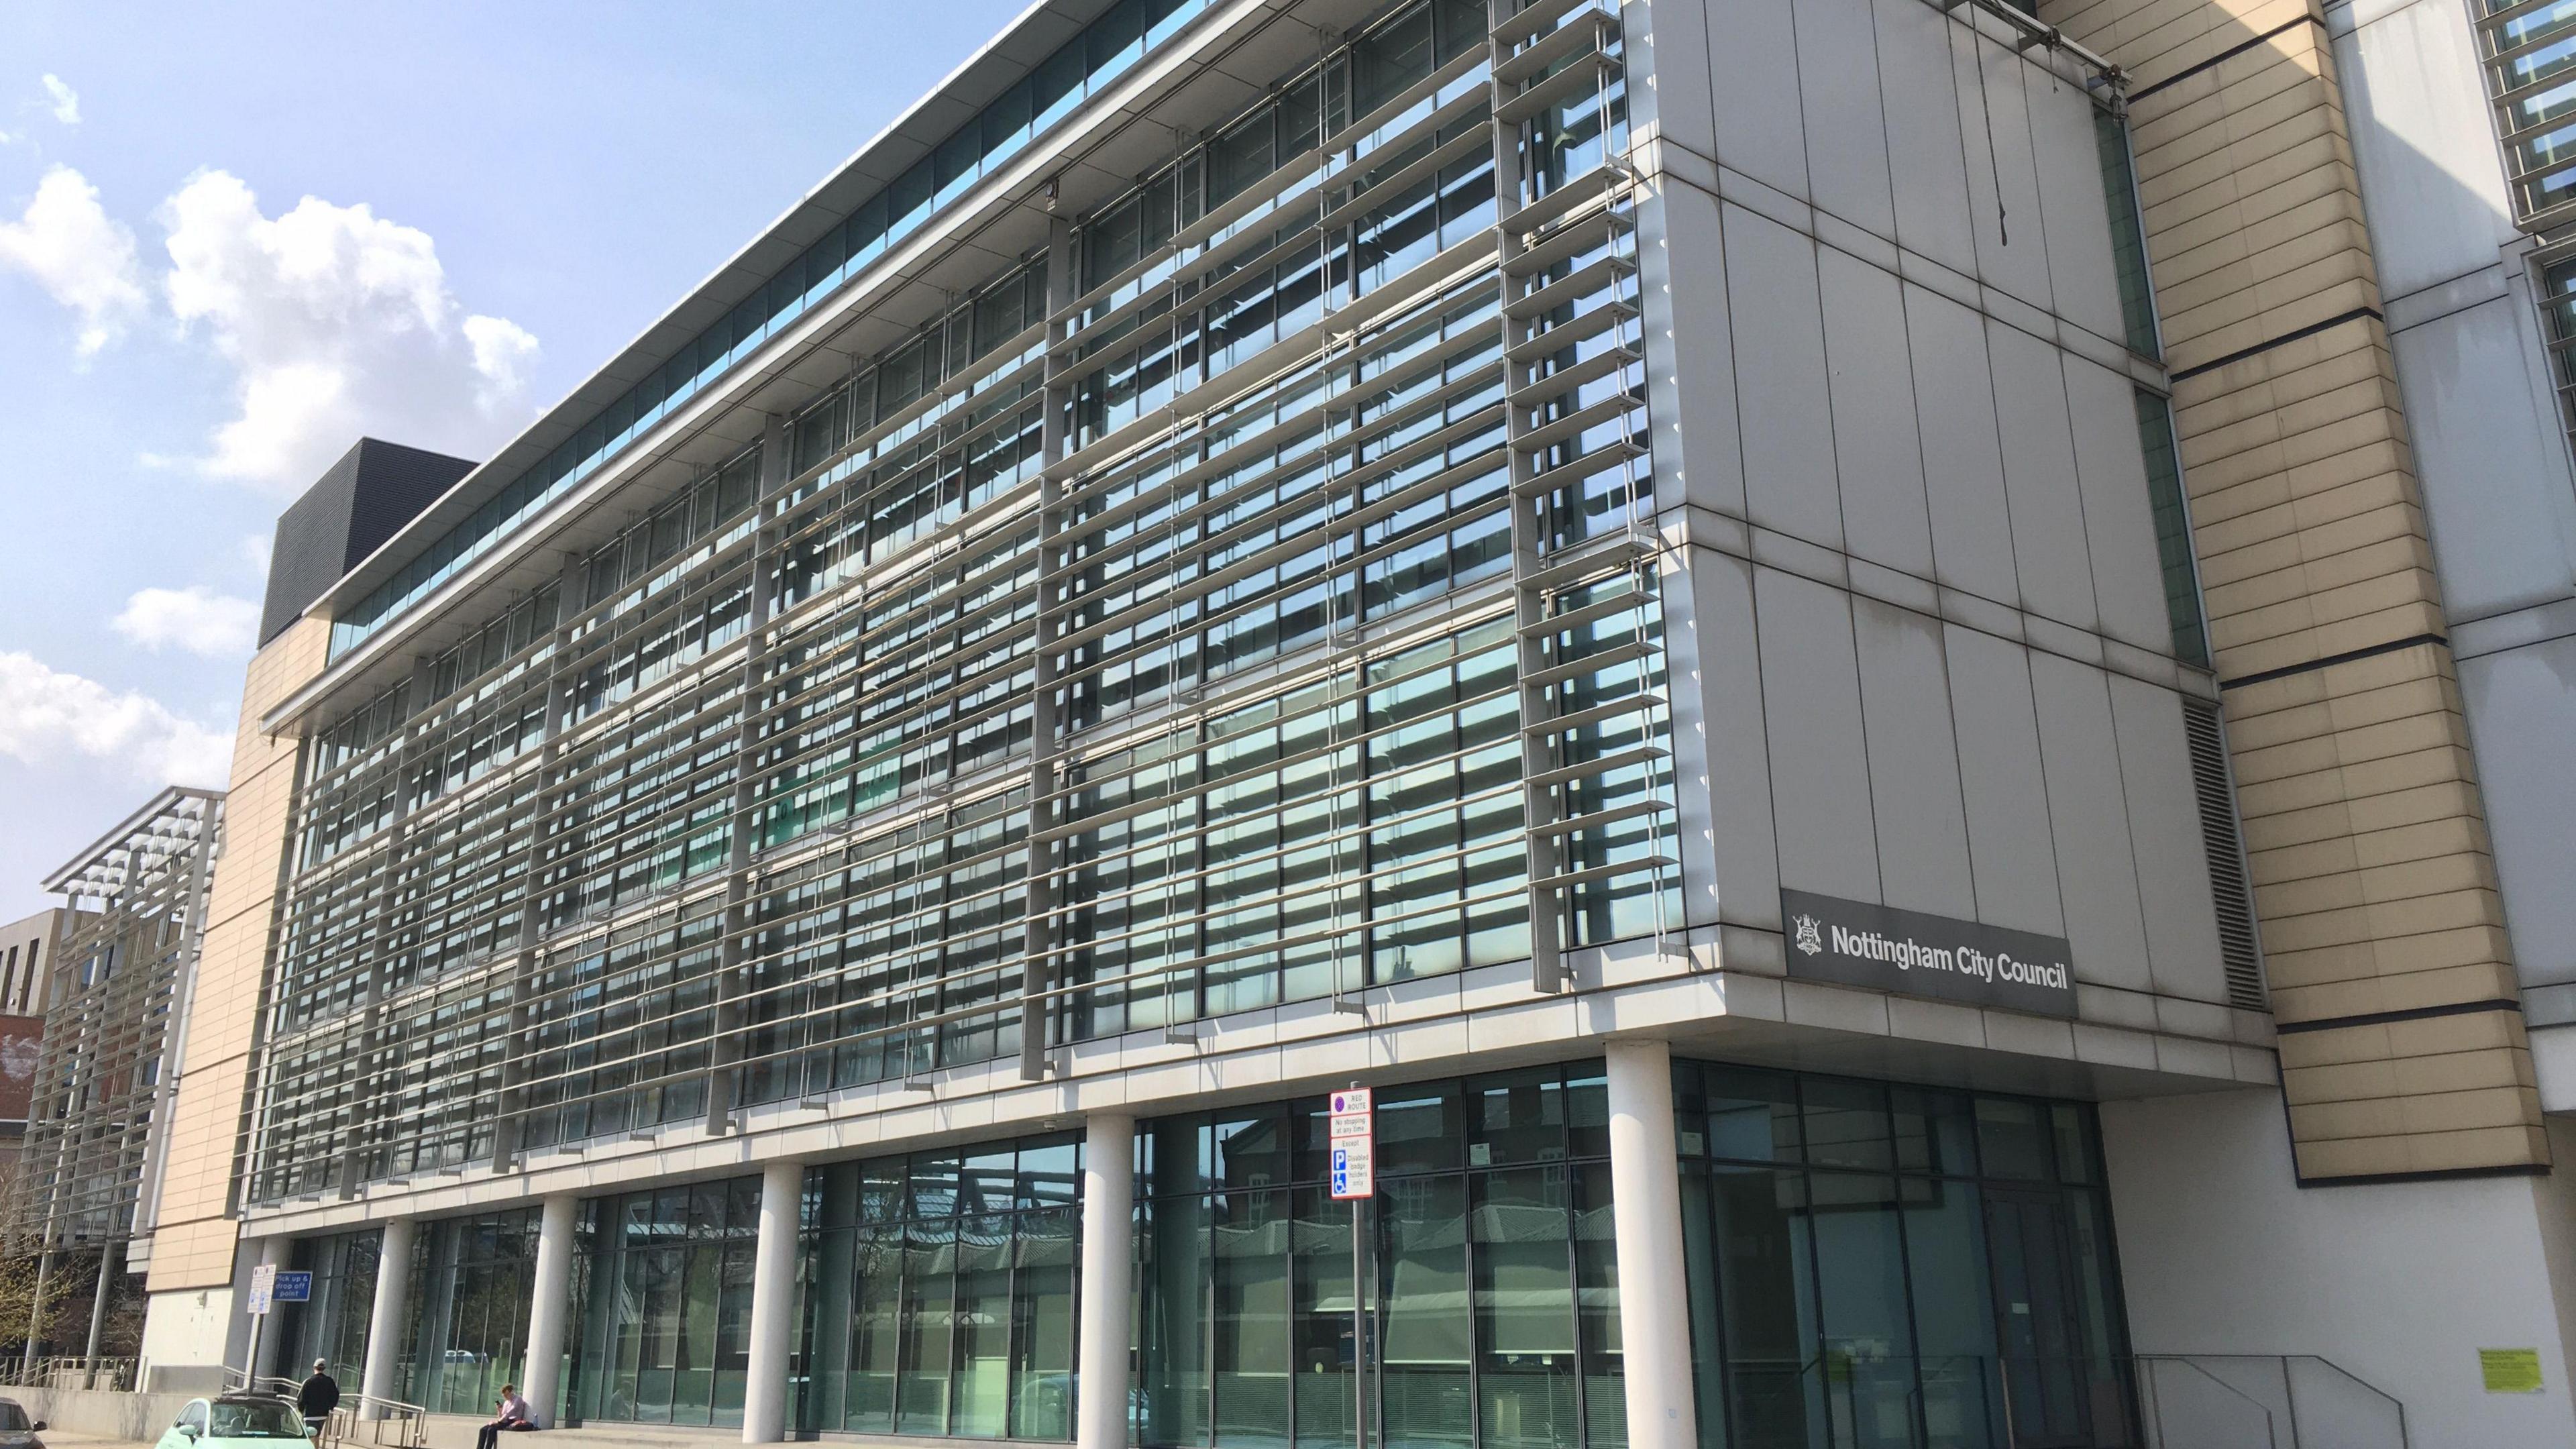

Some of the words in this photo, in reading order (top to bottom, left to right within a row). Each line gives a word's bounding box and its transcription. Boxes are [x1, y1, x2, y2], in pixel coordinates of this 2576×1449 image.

[1831, 924, 1953, 971] Nottingham
[1955, 946, 1994, 983] City
[1997, 953, 2068, 989] Council
[1348, 1102, 1366, 1110] ROUTE
[1344, 1118, 1365, 1126] stopping
[1342, 1139, 1359, 1147] Except
[1336, 1151, 1344, 1169] P
[1350, 1163, 1365, 1171] badge
